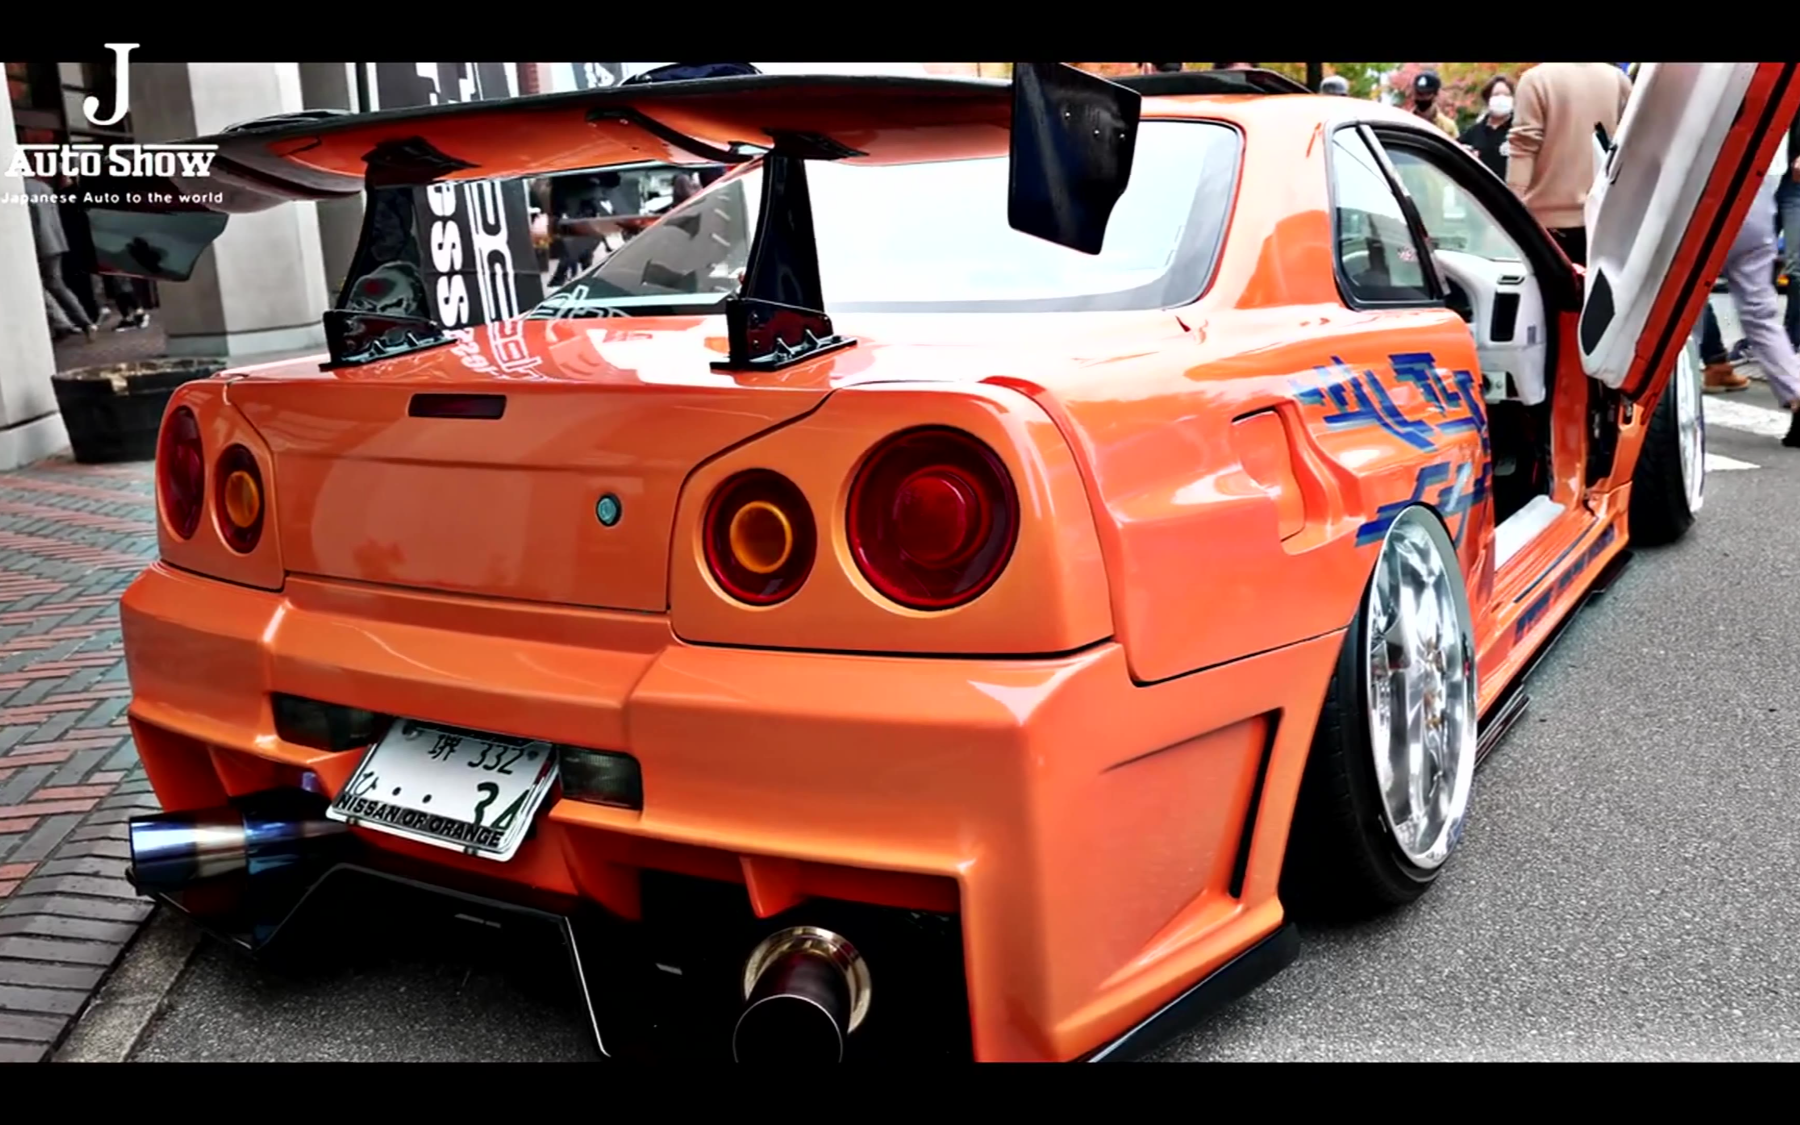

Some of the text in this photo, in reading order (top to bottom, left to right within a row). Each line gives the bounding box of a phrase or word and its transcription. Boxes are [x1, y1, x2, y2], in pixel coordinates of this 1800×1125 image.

[467, 741, 526, 775] 332
[335, 794, 505, 848] NISSAN OF ORANGE
